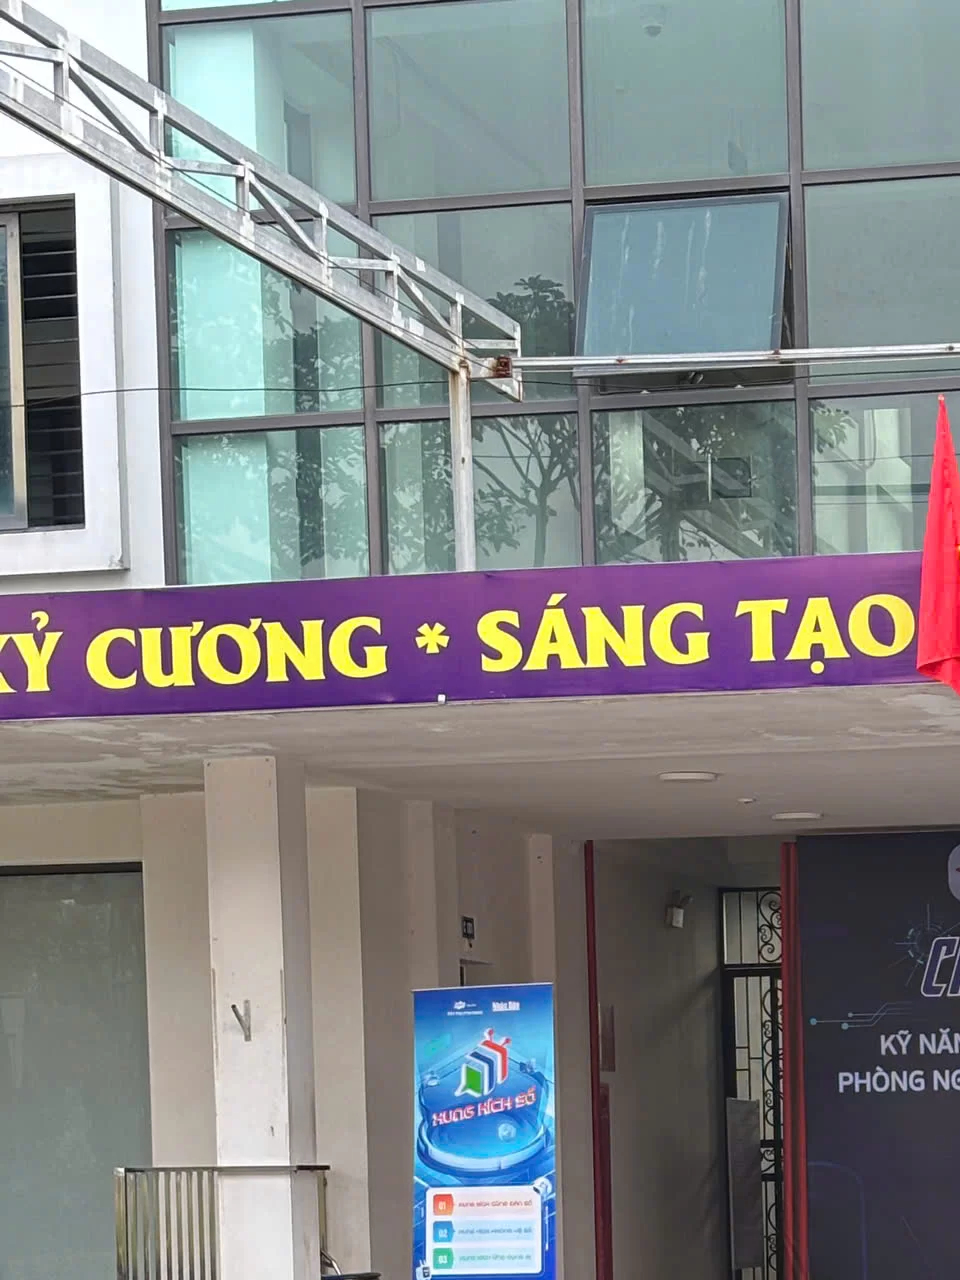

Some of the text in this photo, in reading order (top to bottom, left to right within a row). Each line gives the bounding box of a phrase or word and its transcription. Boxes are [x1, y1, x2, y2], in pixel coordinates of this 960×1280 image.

[85, 615, 388, 690] CƯƠNG
[480, 593, 711, 673] SÁNG
[735, 593, 915, 675] TẠO
[879, 1029, 912, 1055] KỸ
[837, 1067, 926, 1094] PHÒNG
[431, 1105, 475, 1127] XUNG
